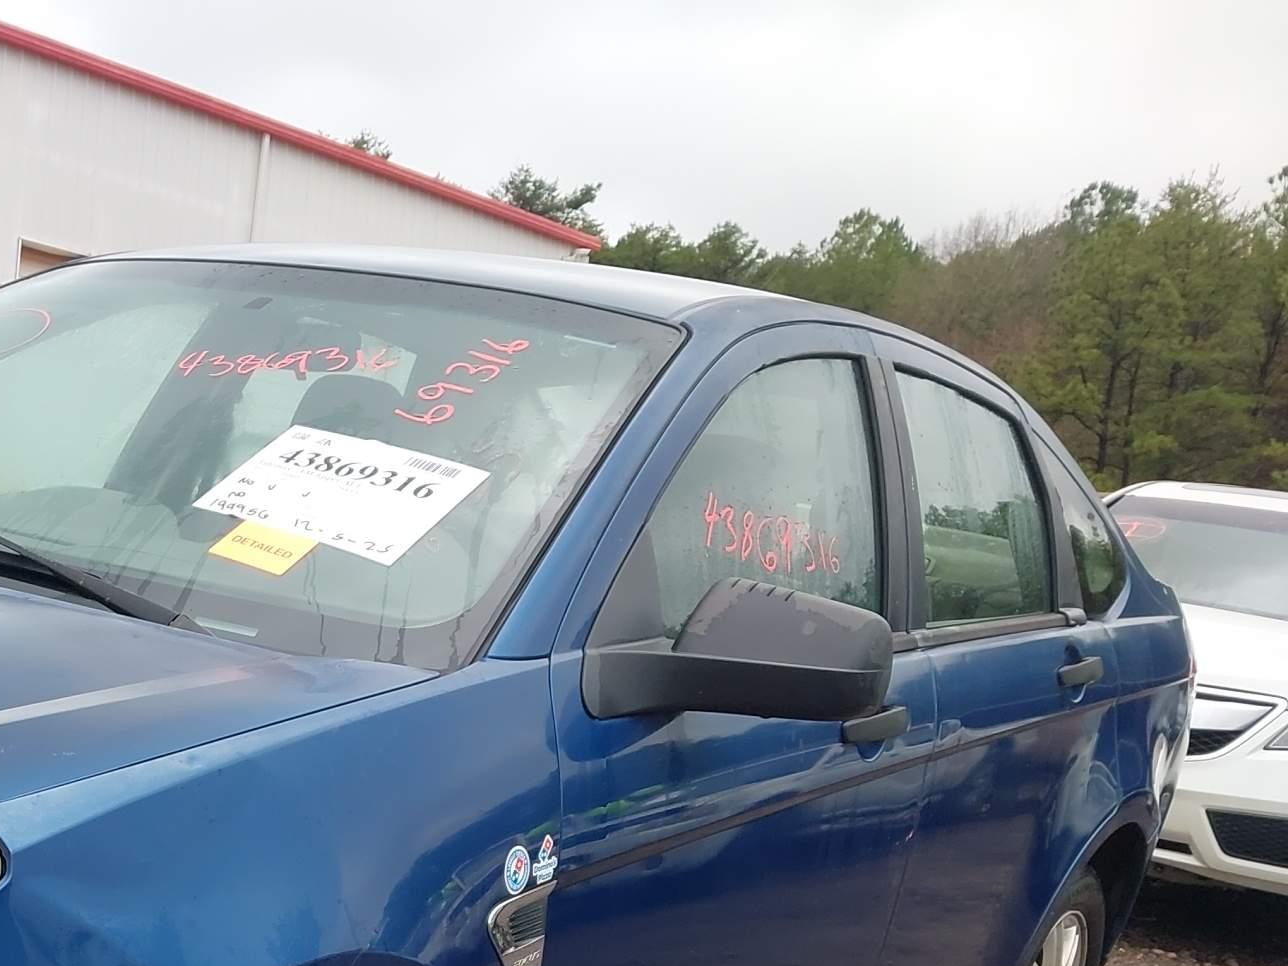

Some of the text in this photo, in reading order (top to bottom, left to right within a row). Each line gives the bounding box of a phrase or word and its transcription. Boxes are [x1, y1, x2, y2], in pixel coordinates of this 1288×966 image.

[178, 346, 400, 377] 43869316
[393, 339, 530, 424] 69316
[278, 449, 440, 499] 43869316
[231, 535, 294, 559] DETAILED
[704, 491, 840, 575] 43869316
